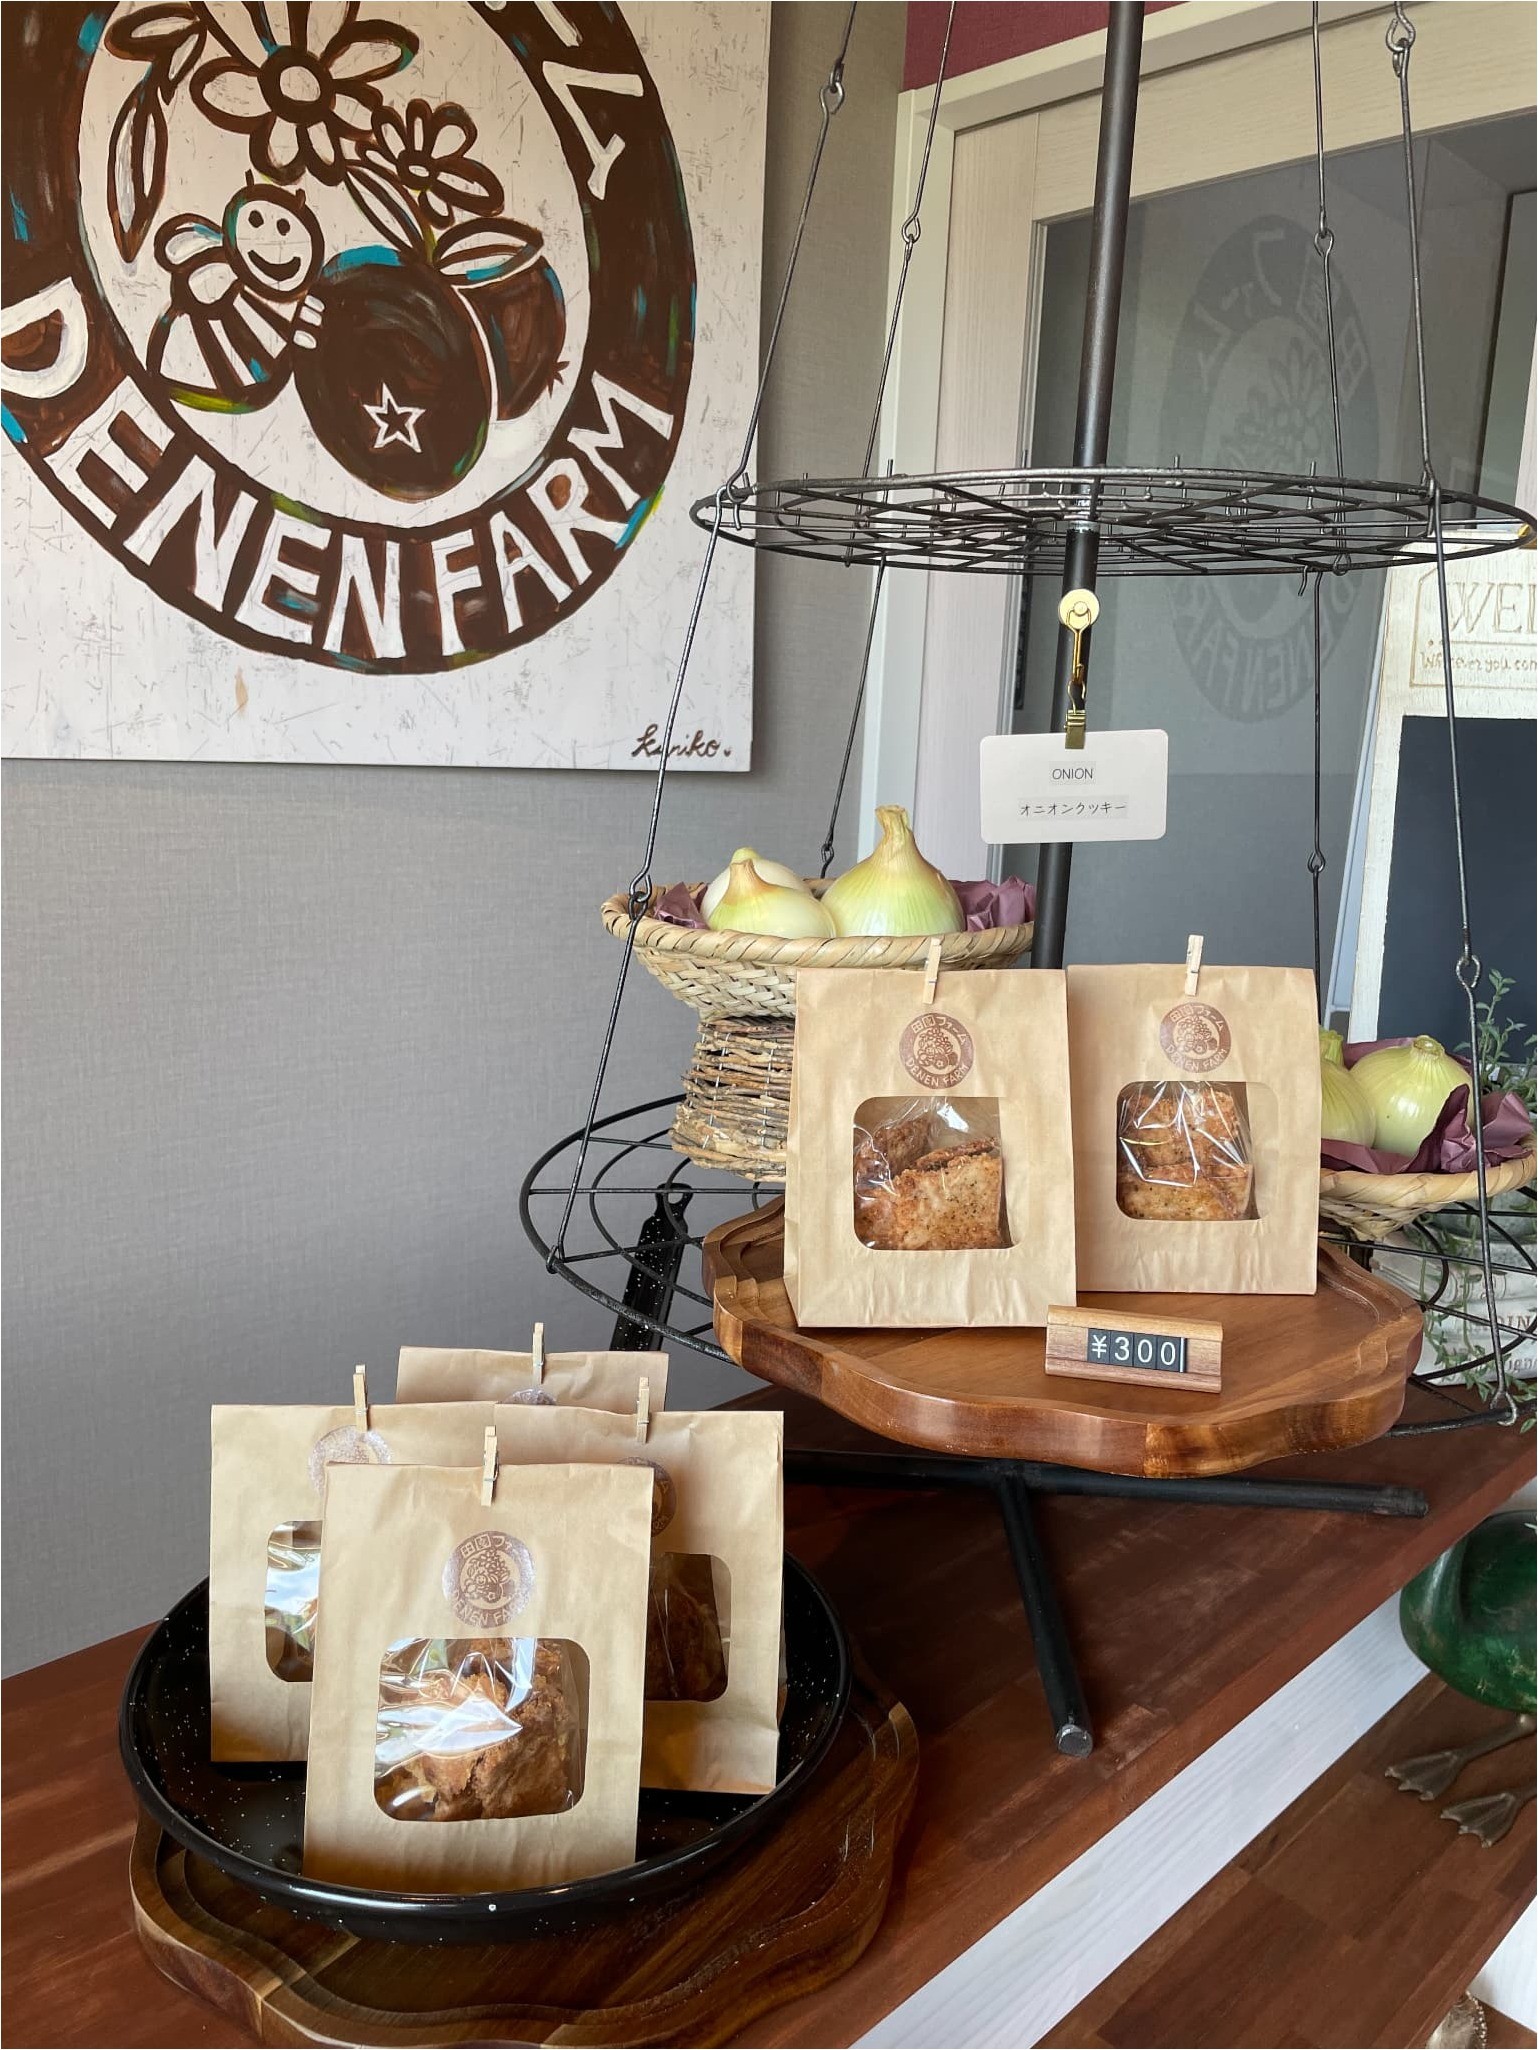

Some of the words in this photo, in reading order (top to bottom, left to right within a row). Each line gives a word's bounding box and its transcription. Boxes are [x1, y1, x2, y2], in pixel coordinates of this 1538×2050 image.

[0, 277, 404, 660] DENEN
[431, 370, 675, 653] FARM
[1052, 767, 1094, 780] ONION
[1020, 801, 1128, 817] オニオンクッキー
[905, 1057, 939, 1087] DENEN
[943, 1063, 970, 1087] FARM
[1091, 1334, 1176, 1366] ¥300
